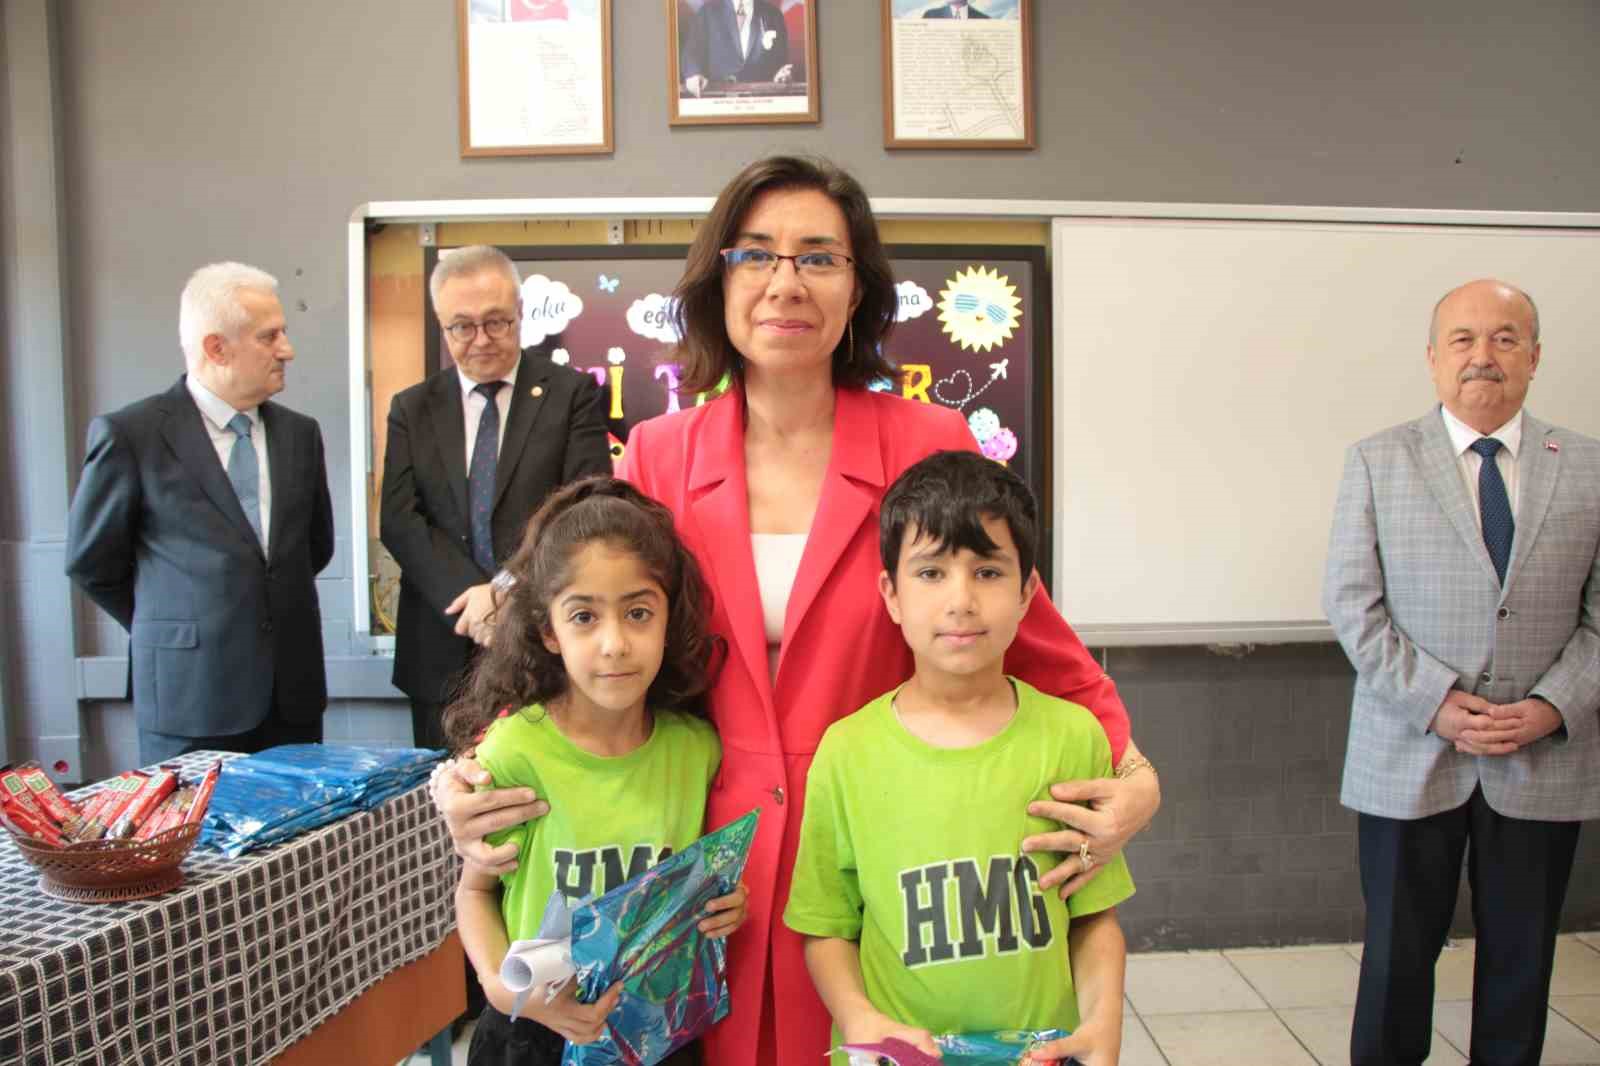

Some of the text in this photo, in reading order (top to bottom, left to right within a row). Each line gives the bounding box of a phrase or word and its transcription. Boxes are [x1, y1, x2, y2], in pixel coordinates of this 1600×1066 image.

[899, 293, 921, 306] na
[553, 843, 673, 903] HM
[899, 854, 1054, 970] HMG
